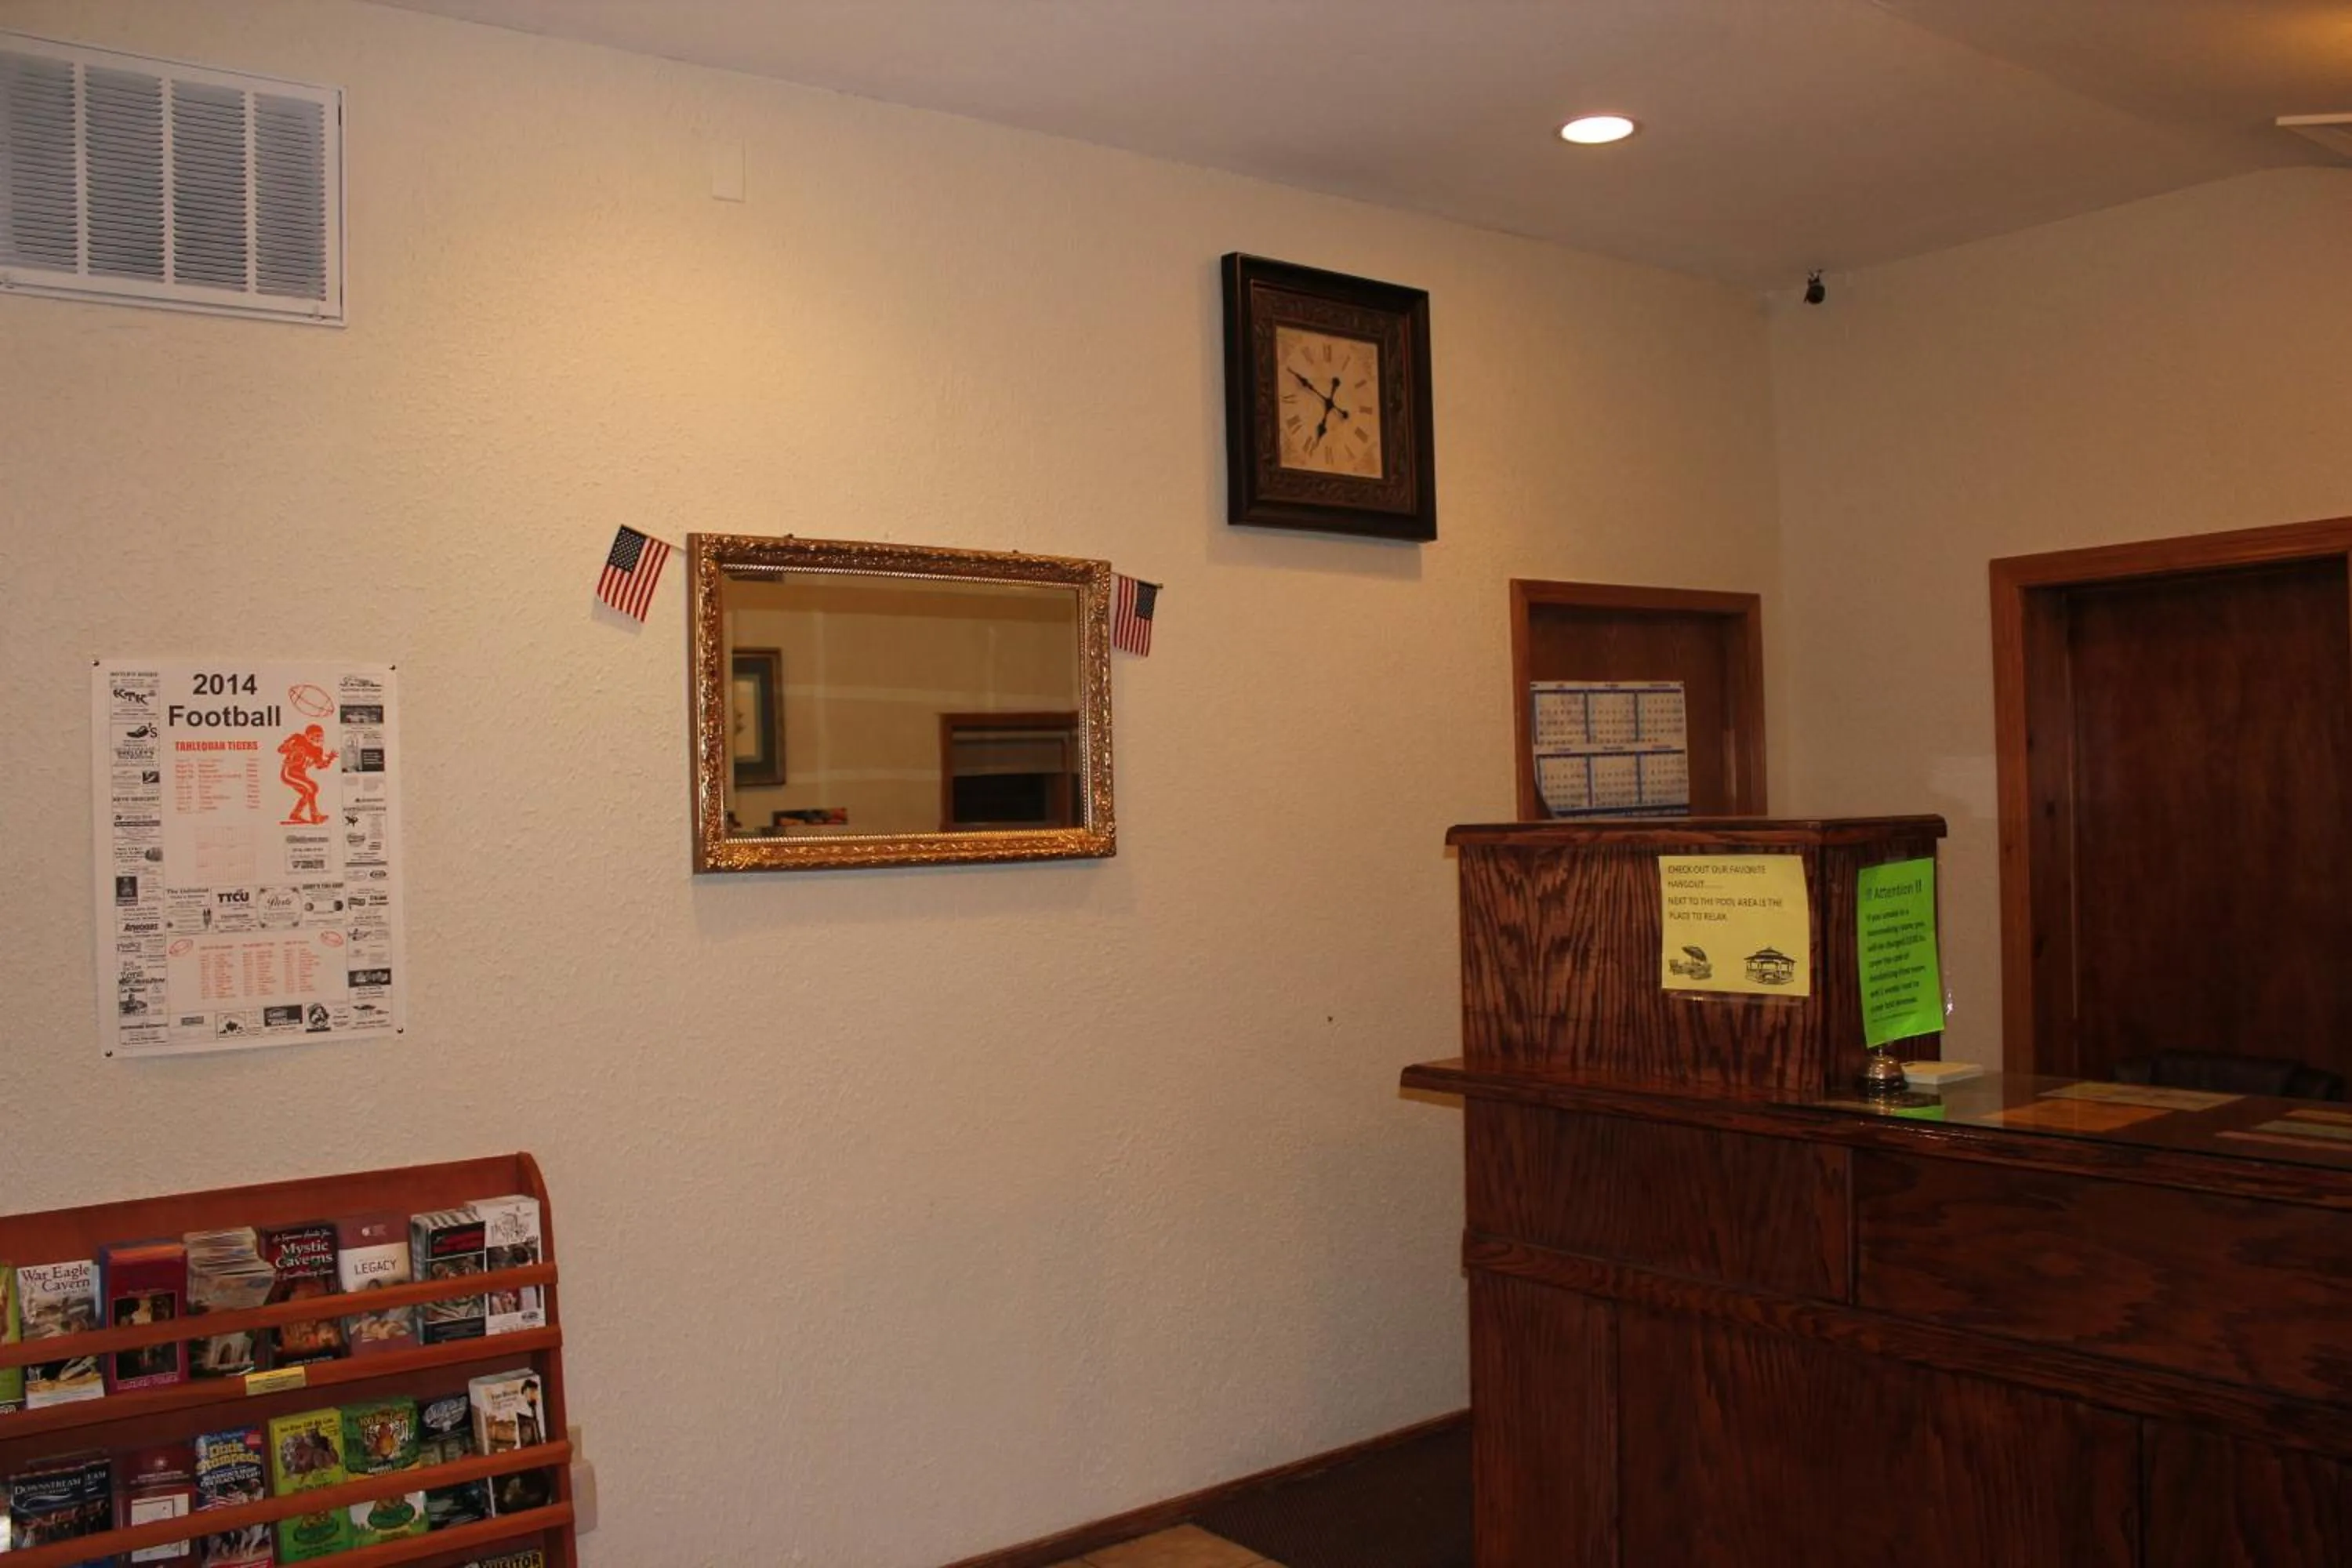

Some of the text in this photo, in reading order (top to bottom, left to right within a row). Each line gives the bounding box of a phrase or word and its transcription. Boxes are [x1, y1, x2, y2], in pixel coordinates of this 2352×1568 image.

[192, 673, 258, 695] 2014
[169, 705, 281, 728] Football
[227, 740, 259, 750] TIGERS
[1668, 865, 1692, 874] CHECK
[1693, 865, 1710, 874] OUT
[1730, 865, 1766, 874] FAVORITE
[217, 892, 250, 904] TTCU
[1874, 884, 1914, 899] Attention
[1737, 898, 1758, 908] AREA
[281, 1240, 329, 1256] Mystic
[275, 1254, 334, 1269] Caverns
[353, 1258, 397, 1276] LEGACY
[22, 1264, 90, 1282] War Eagle
[42, 1279, 91, 1293] Cavern
